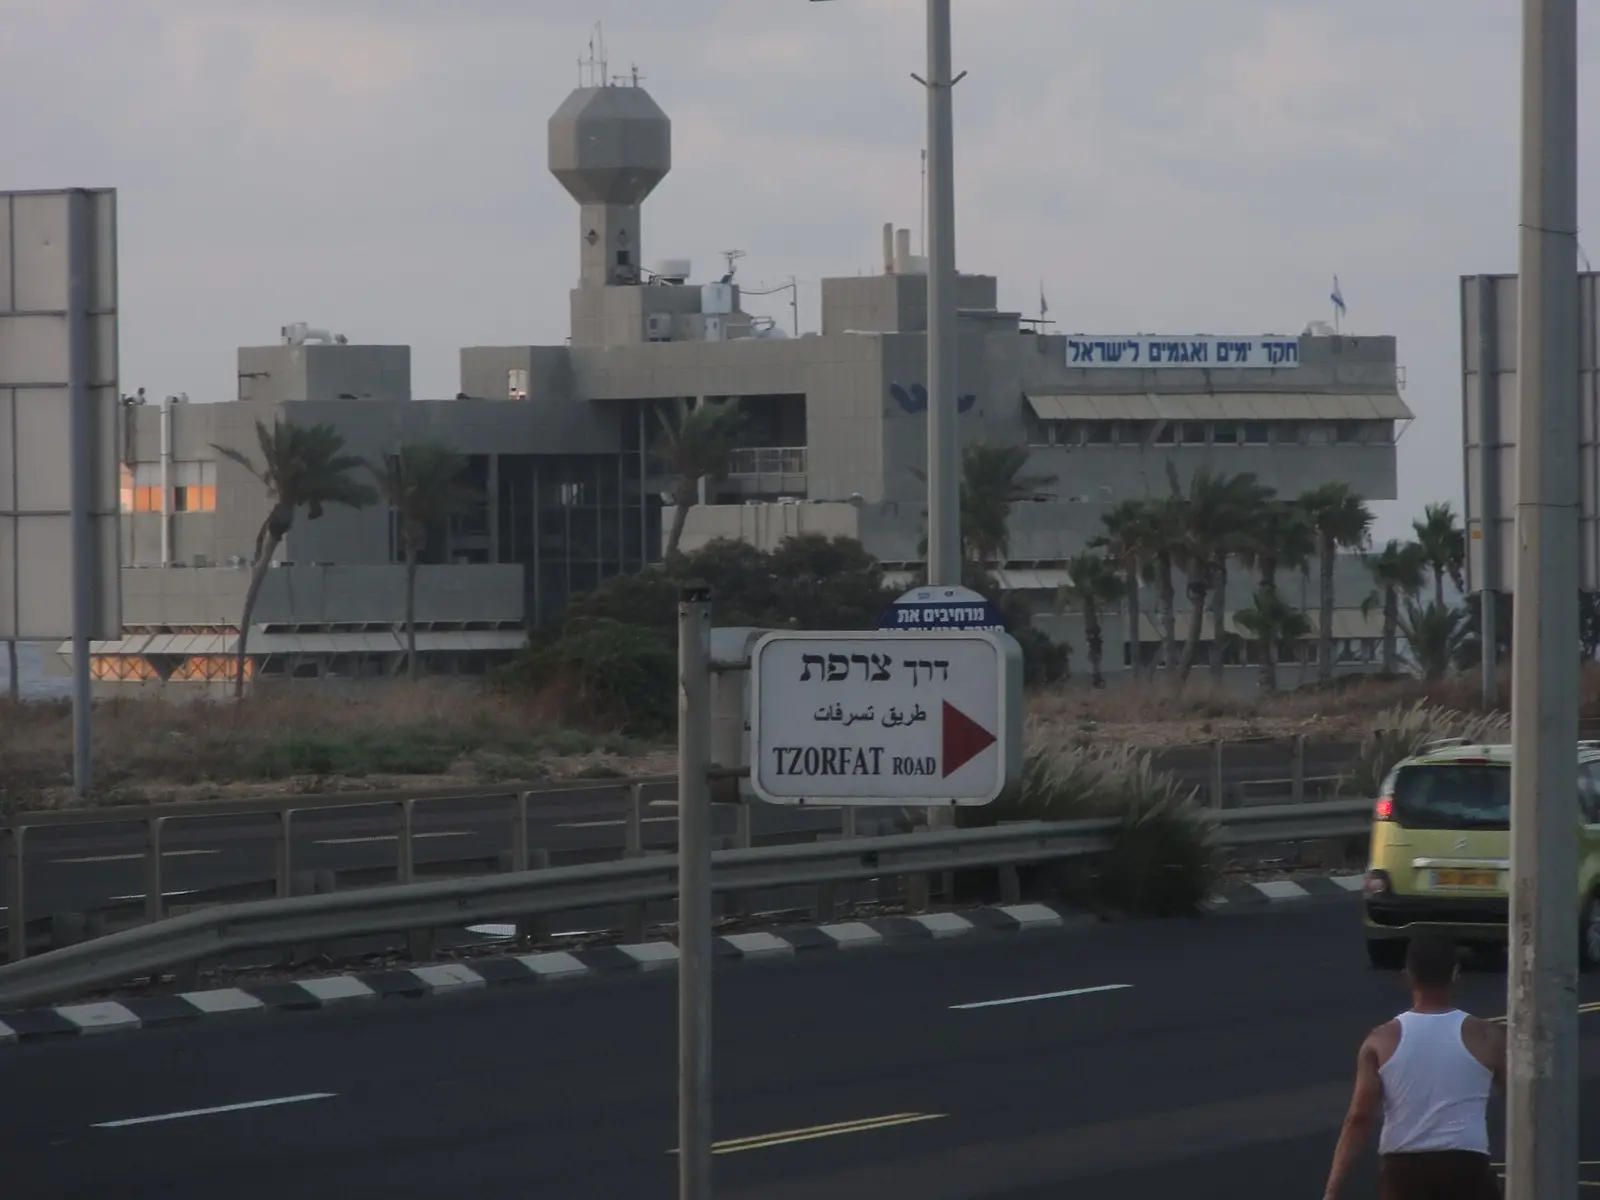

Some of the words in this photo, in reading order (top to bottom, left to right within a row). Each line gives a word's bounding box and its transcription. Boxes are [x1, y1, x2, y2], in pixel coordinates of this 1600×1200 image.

[1068, 339, 1140, 362] לישראל
[1148, 341, 1208, 363] ואגמים
[1217, 341, 1252, 362] ימים
[1261, 341, 1297, 365] חקר
[897, 609, 920, 623] את
[923, 607, 985, 622] מרחיבים
[799, 653, 893, 682] צרפת
[903, 659, 949, 688] דרך
[813, 702, 875, 727] تسرفات
[881, 703, 927, 728] طريق
[772, 747, 885, 776] TZORFAT
[892, 756, 937, 776] ROAD
